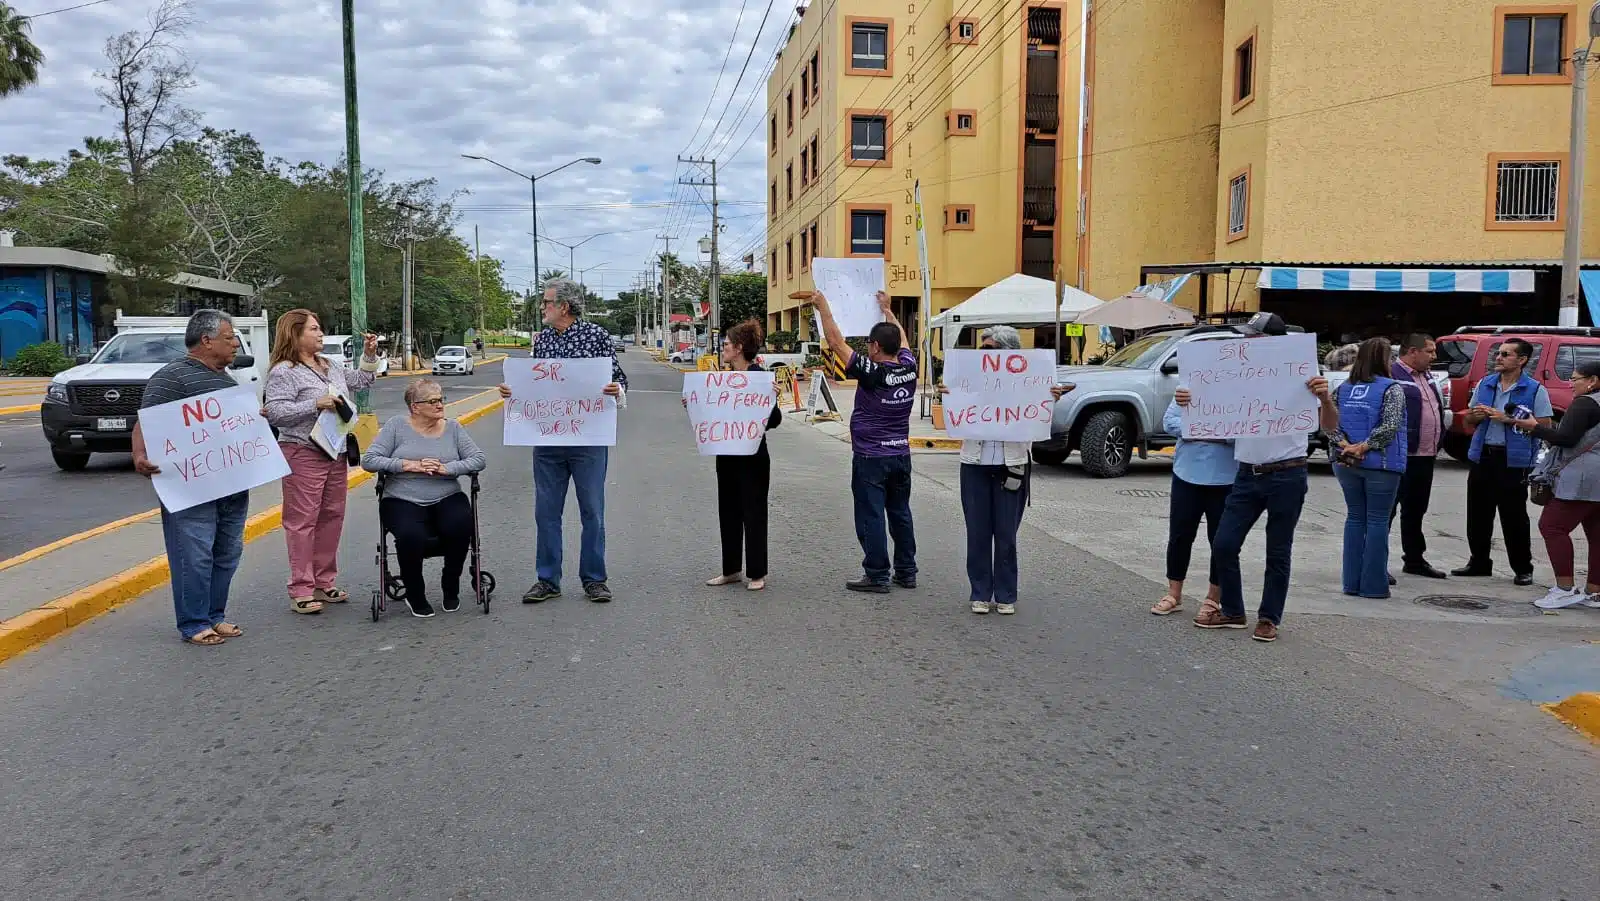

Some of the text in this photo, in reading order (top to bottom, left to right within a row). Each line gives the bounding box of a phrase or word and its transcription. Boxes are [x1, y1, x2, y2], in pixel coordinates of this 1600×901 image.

[1217, 341, 1250, 361] SR
[532, 361, 566, 381] SR.
[982, 353, 1028, 374] NO
[706, 372, 749, 389] NO
[959, 379, 970, 394] A
[690, 389, 770, 411] A LA FERIA
[1186, 395, 1286, 417] MUNICIPAL
[182, 396, 222, 427] NO
[946, 400, 1054, 428] VECINOS
[163, 411, 256, 457] A LA FERIA
[537, 418, 585, 437] DOR
[173, 436, 271, 482] VECINOS
